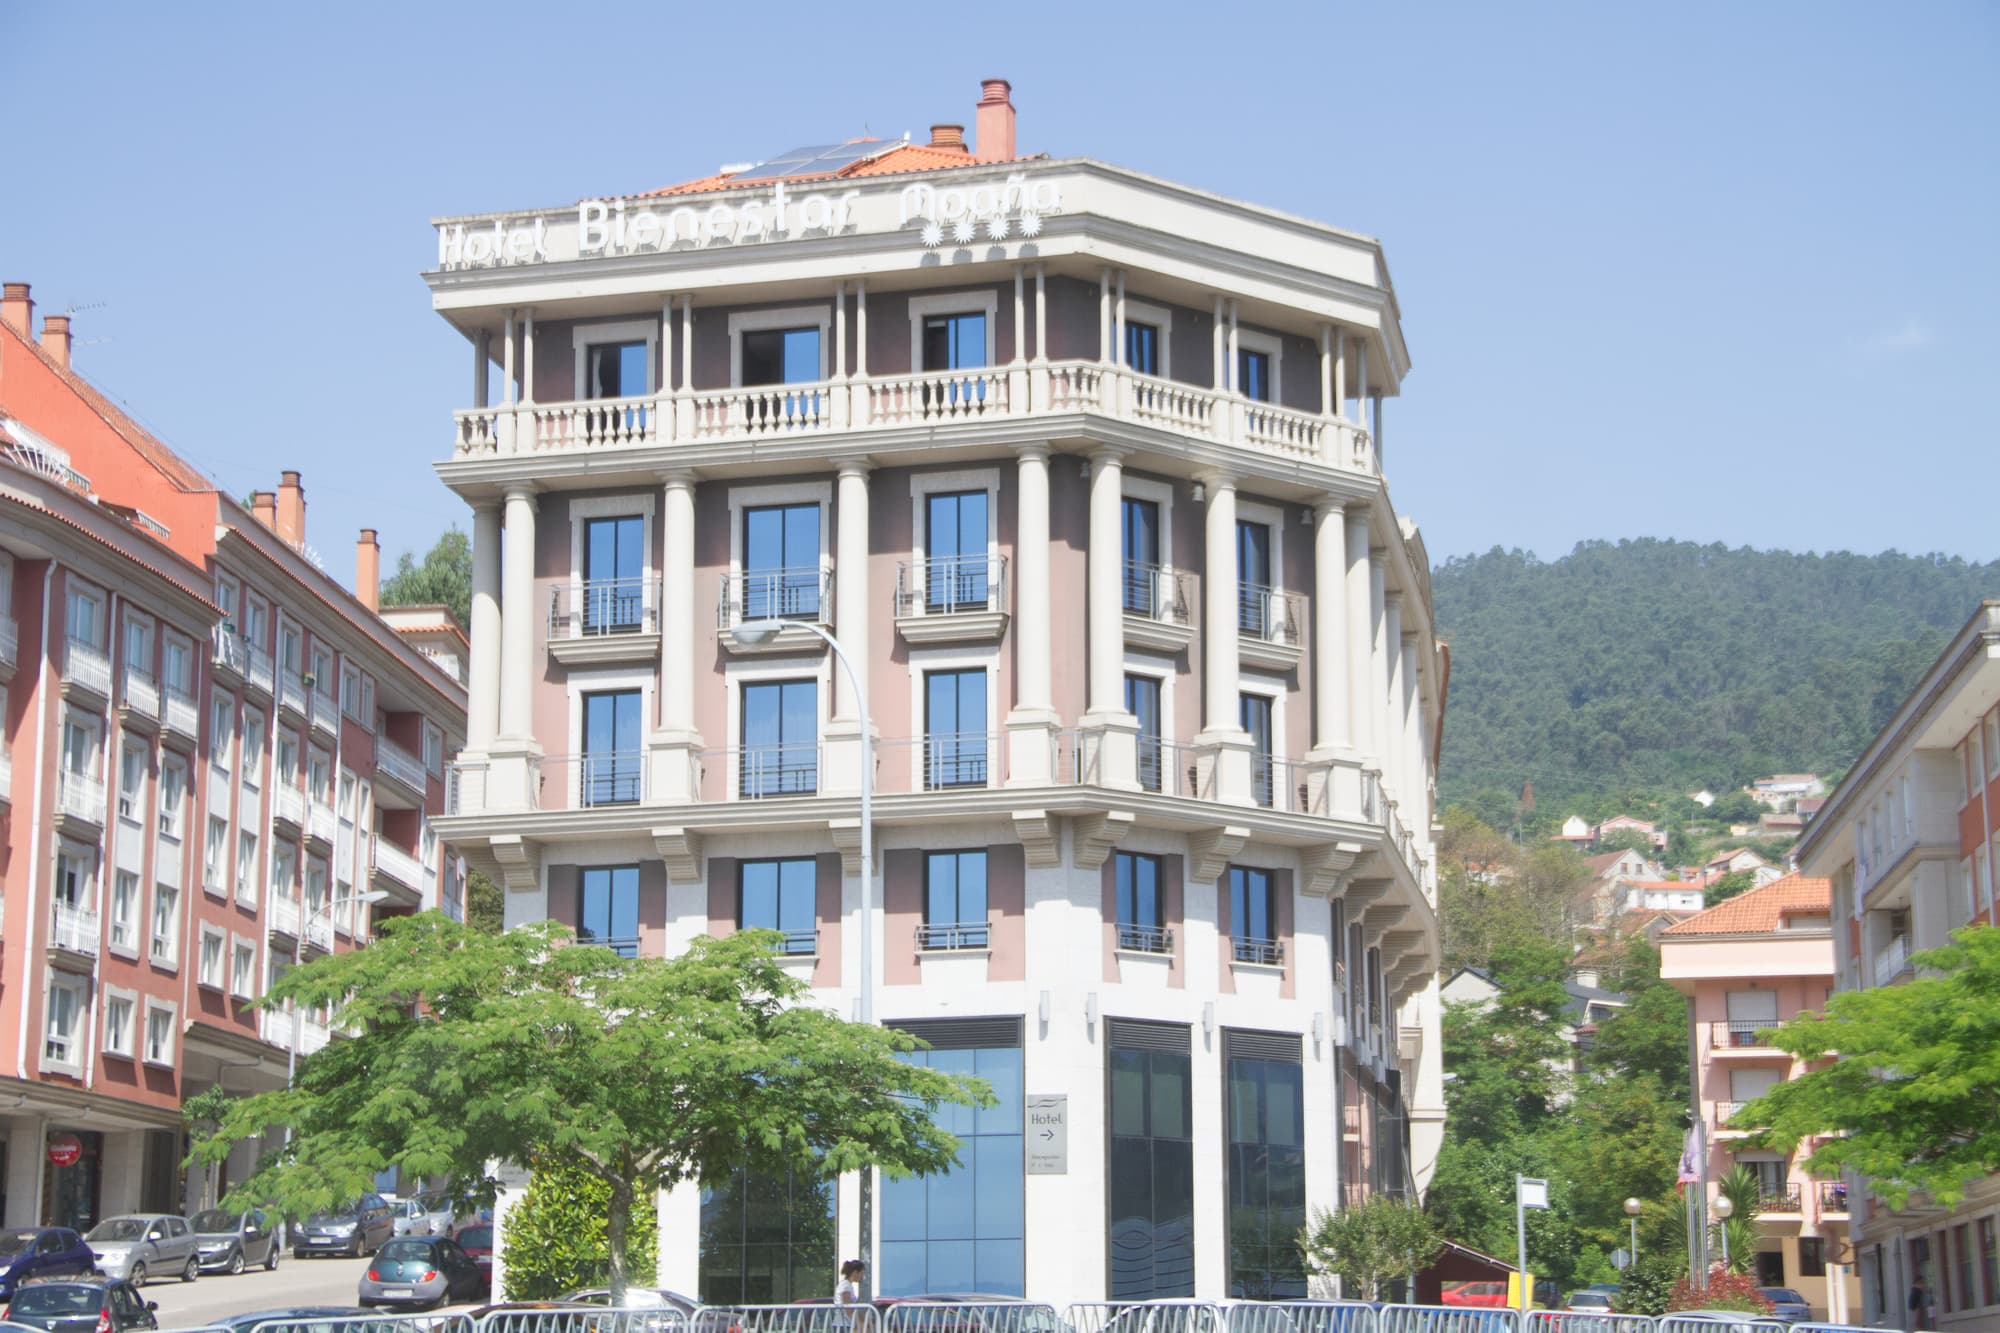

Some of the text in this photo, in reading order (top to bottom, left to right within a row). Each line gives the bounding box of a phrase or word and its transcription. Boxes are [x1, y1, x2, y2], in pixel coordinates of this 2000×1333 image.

[438, 173, 1061, 265] Hotel Bienestar Moaña
[1031, 1113, 1063, 1125] Hotel
